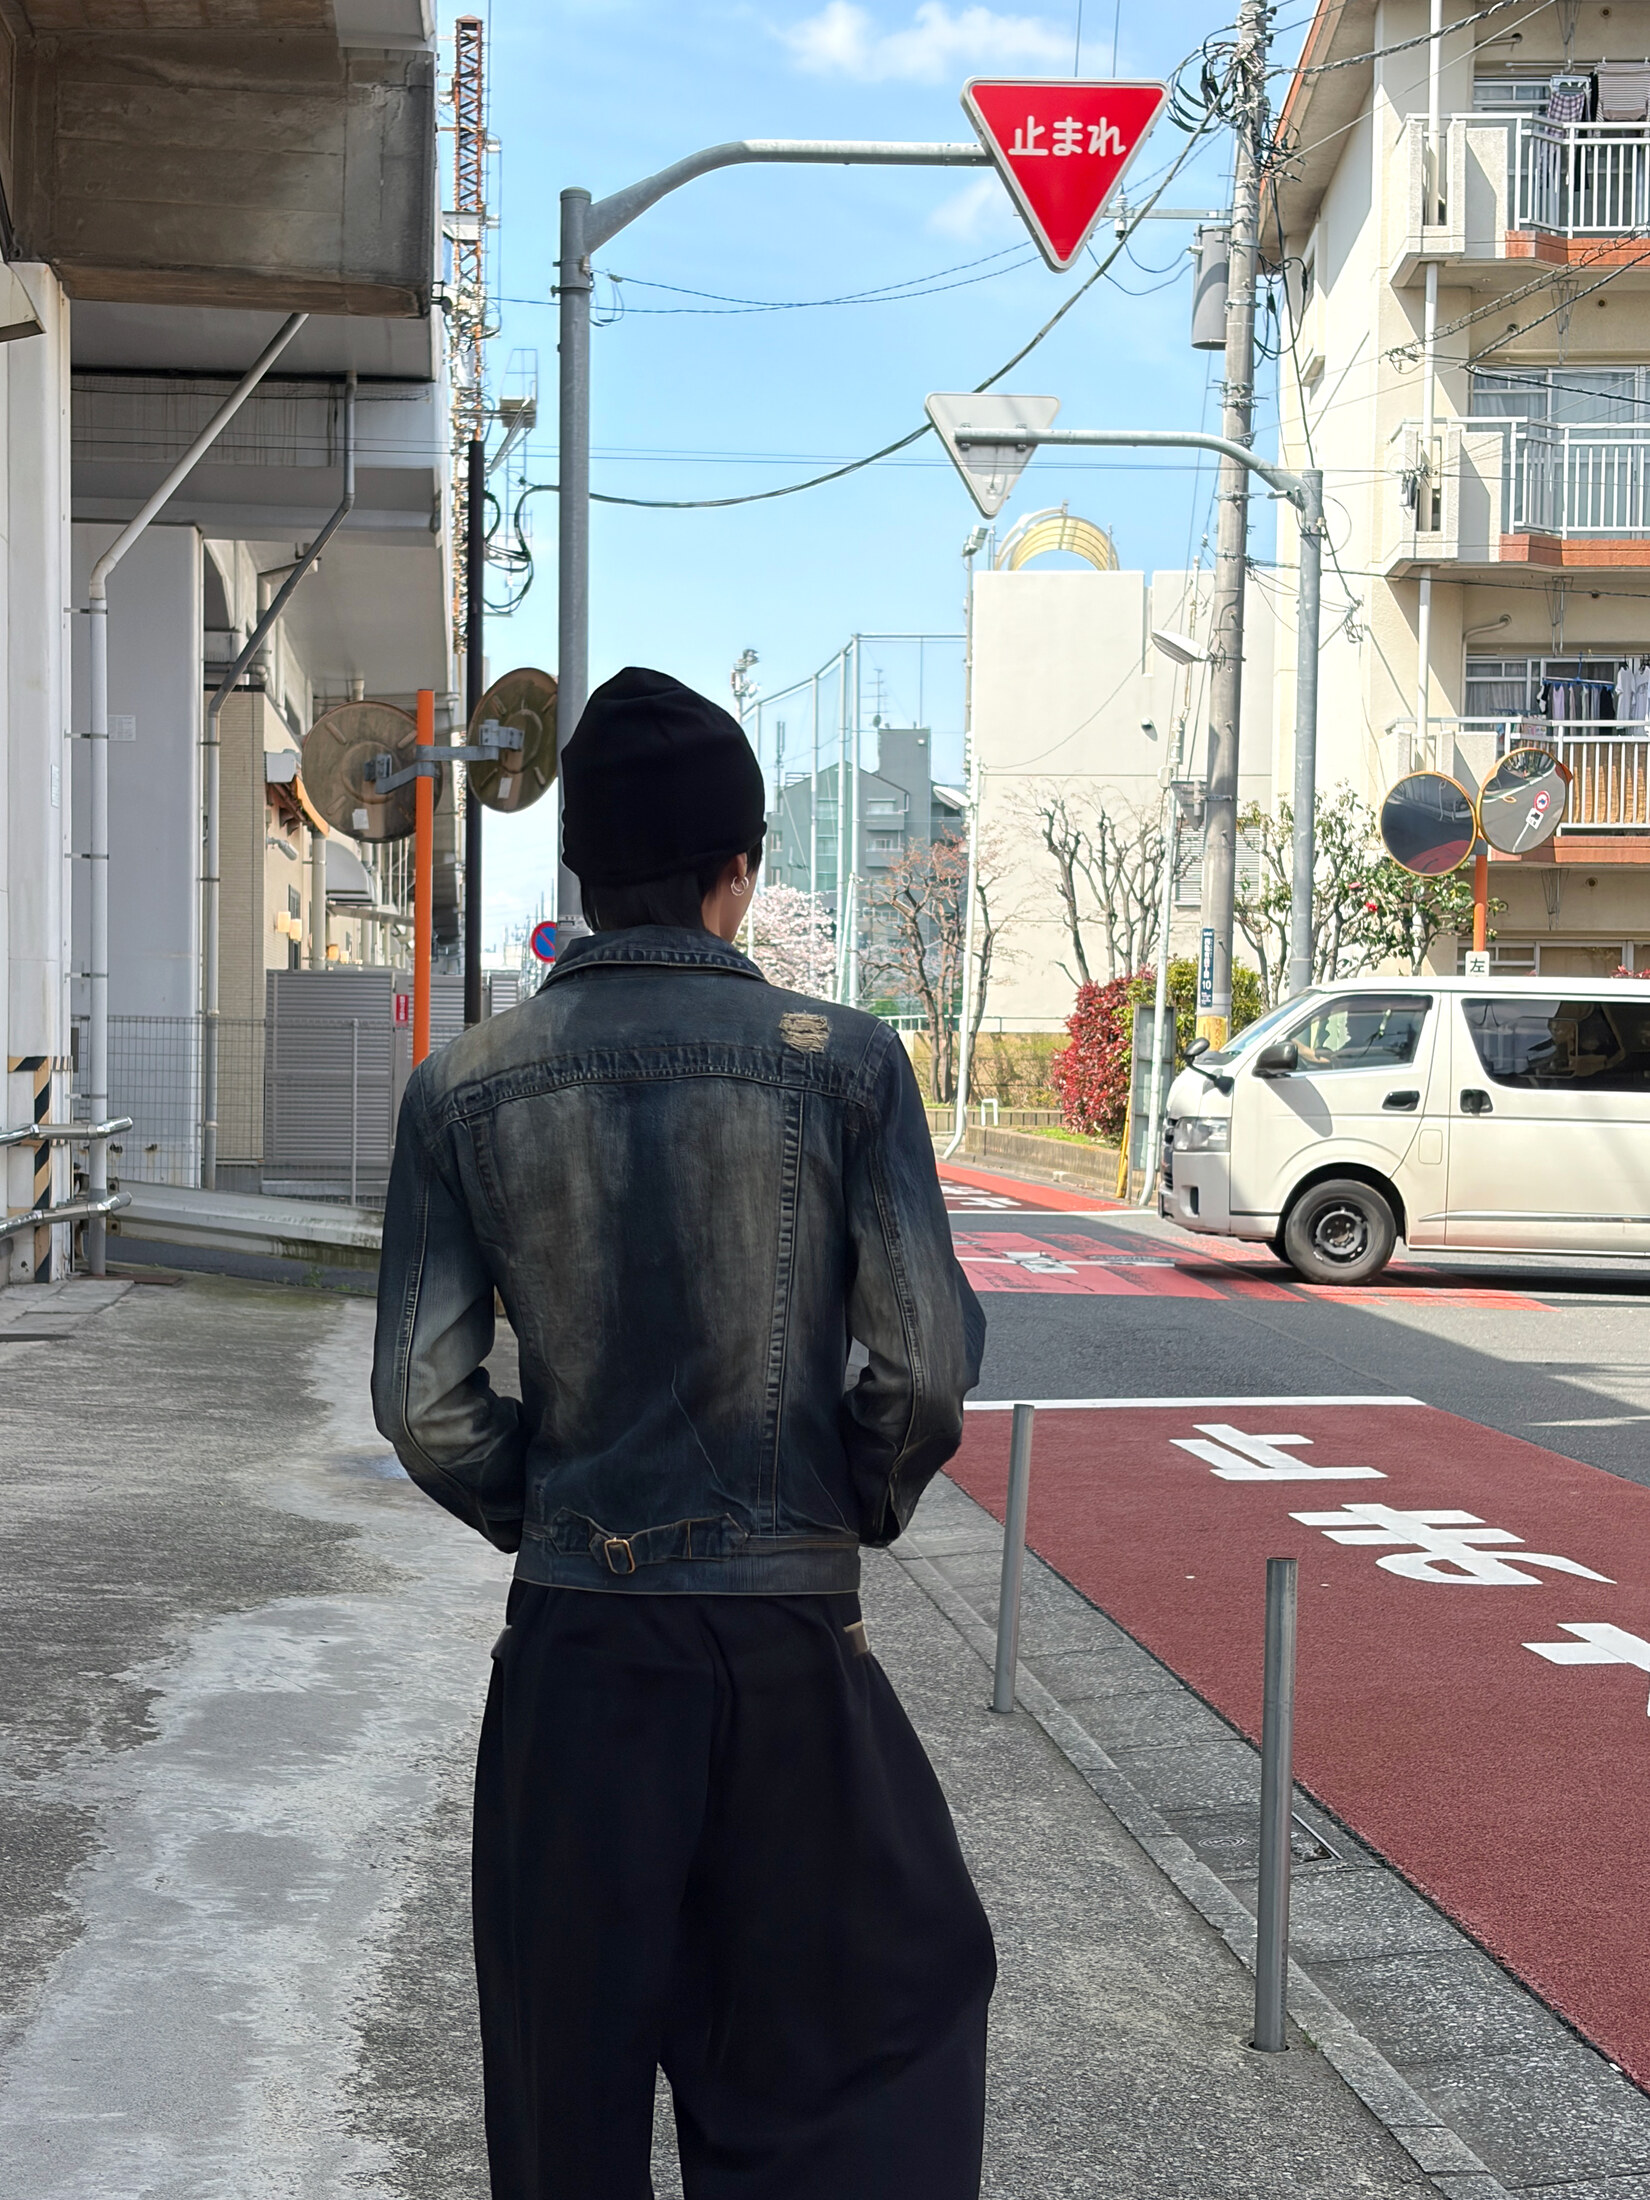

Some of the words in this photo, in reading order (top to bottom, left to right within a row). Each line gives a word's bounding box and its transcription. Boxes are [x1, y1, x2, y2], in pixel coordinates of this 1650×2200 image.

[1008, 115, 1126, 157] 止まれ
[1202, 980, 1212, 990] 10
